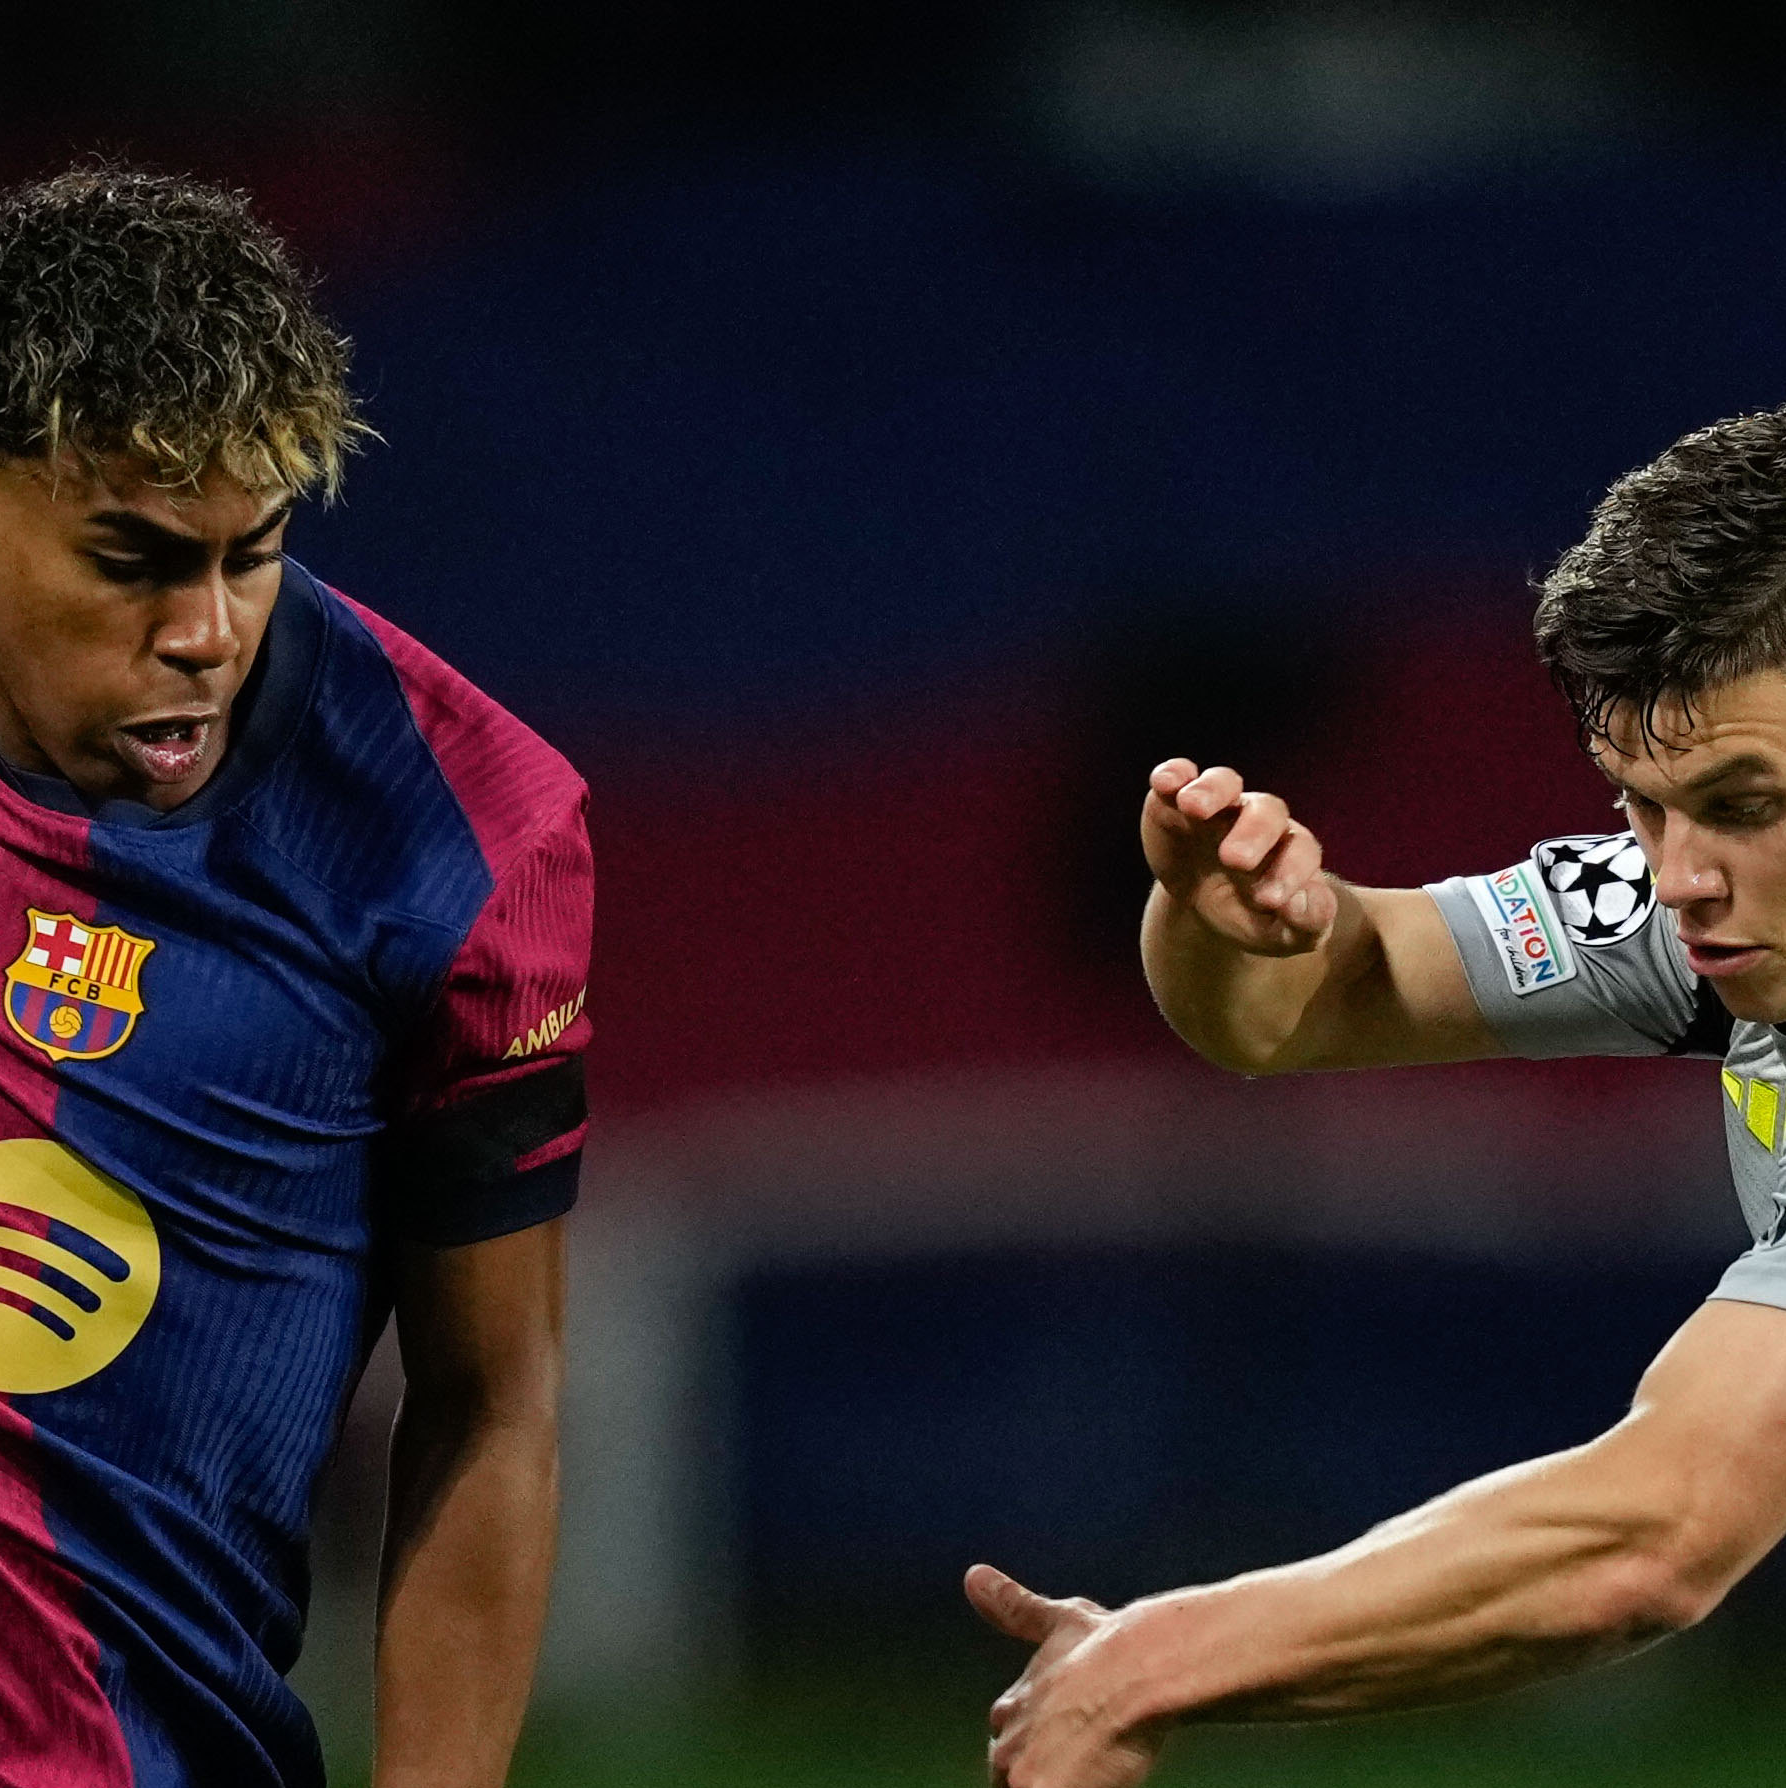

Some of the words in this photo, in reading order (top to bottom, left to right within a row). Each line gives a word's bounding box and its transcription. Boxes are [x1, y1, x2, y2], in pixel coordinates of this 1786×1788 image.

[1495, 870, 1555, 983] NDATION
[49, 973, 101, 1001] FCB
[1493, 928, 1511, 941] for
[1505, 945, 1525, 987] children
